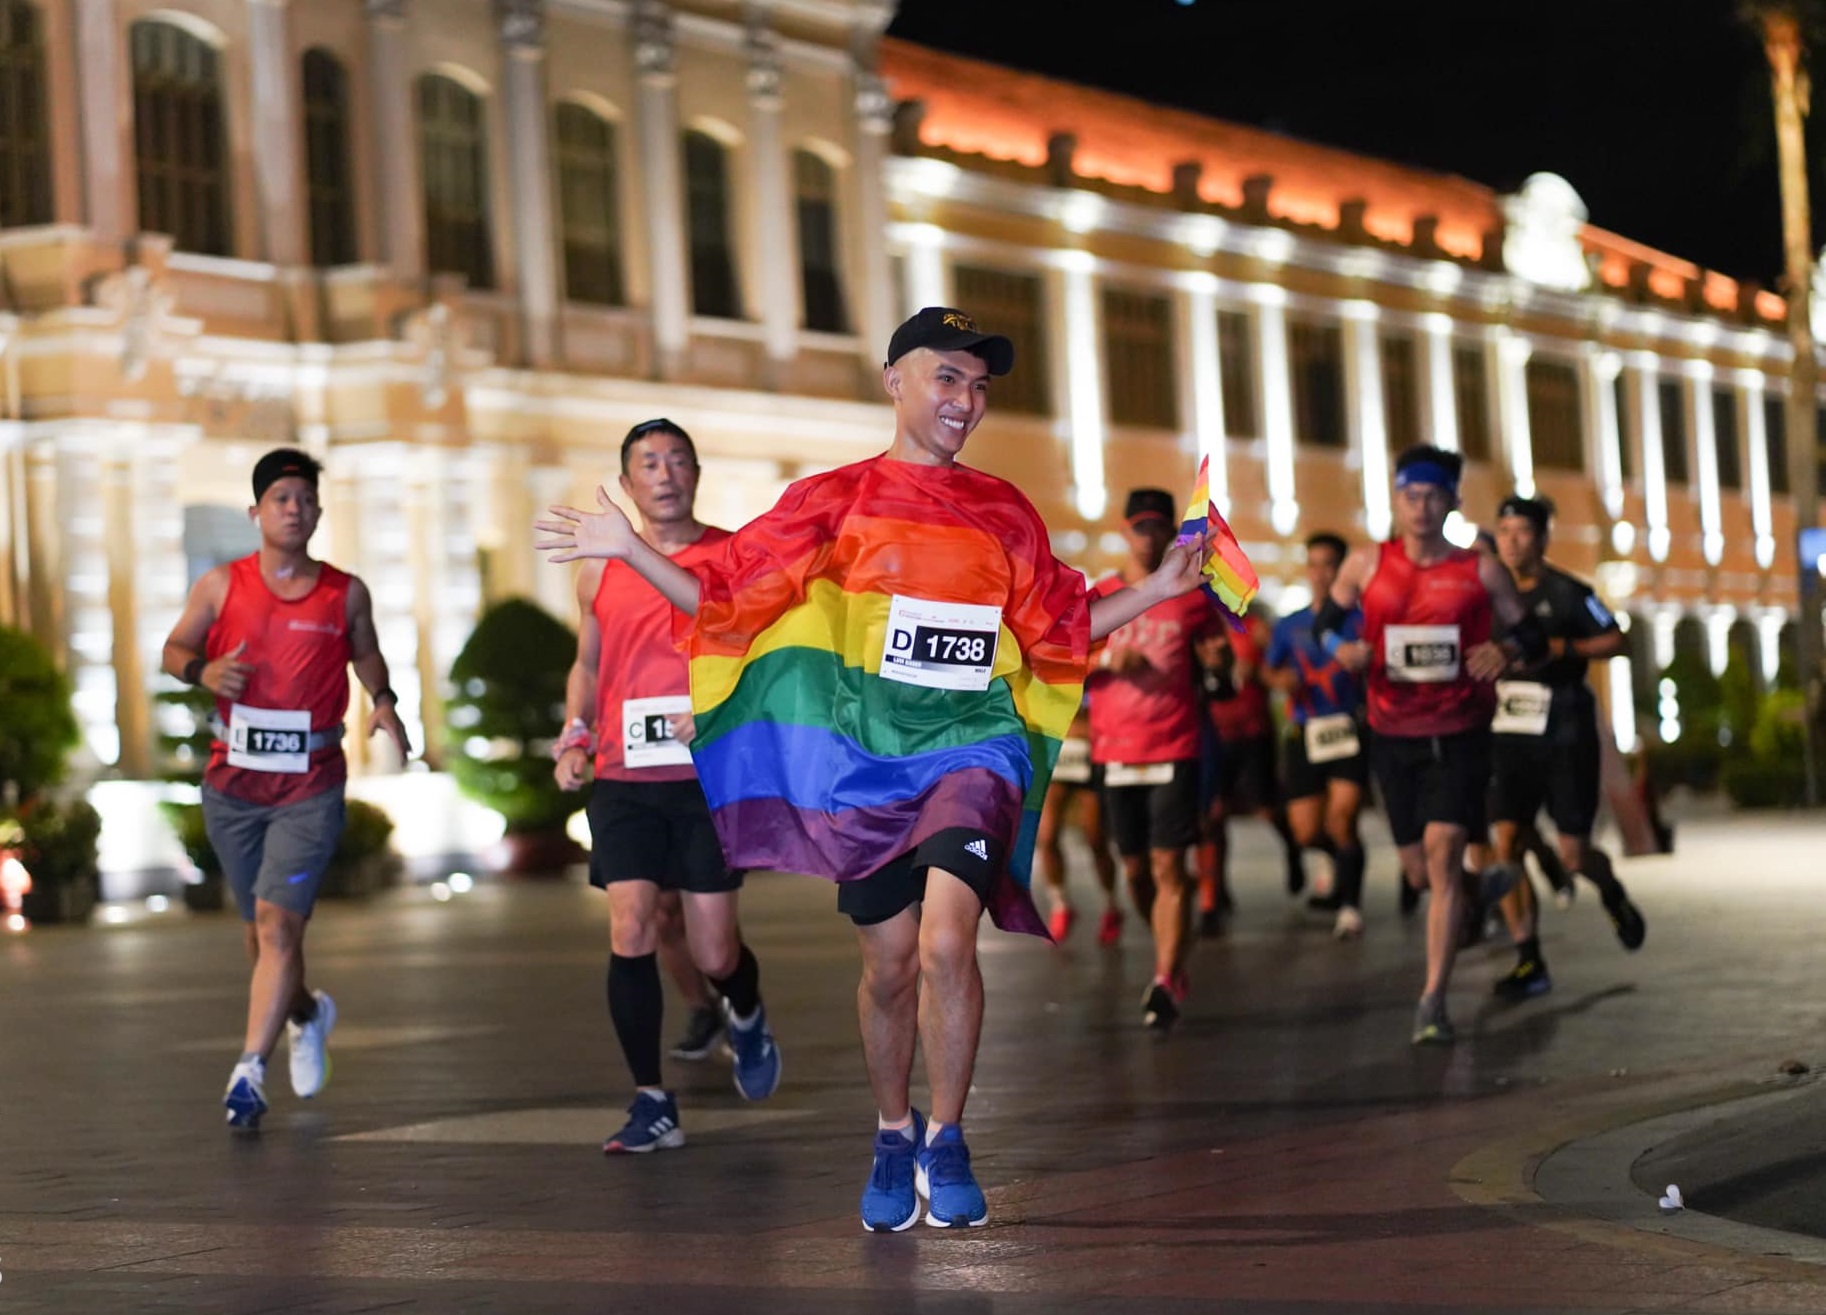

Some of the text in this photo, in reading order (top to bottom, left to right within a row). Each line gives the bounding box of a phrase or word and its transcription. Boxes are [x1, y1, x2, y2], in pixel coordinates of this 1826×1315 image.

[892, 629, 986, 662] D 1738
[629, 721, 643, 739] C
